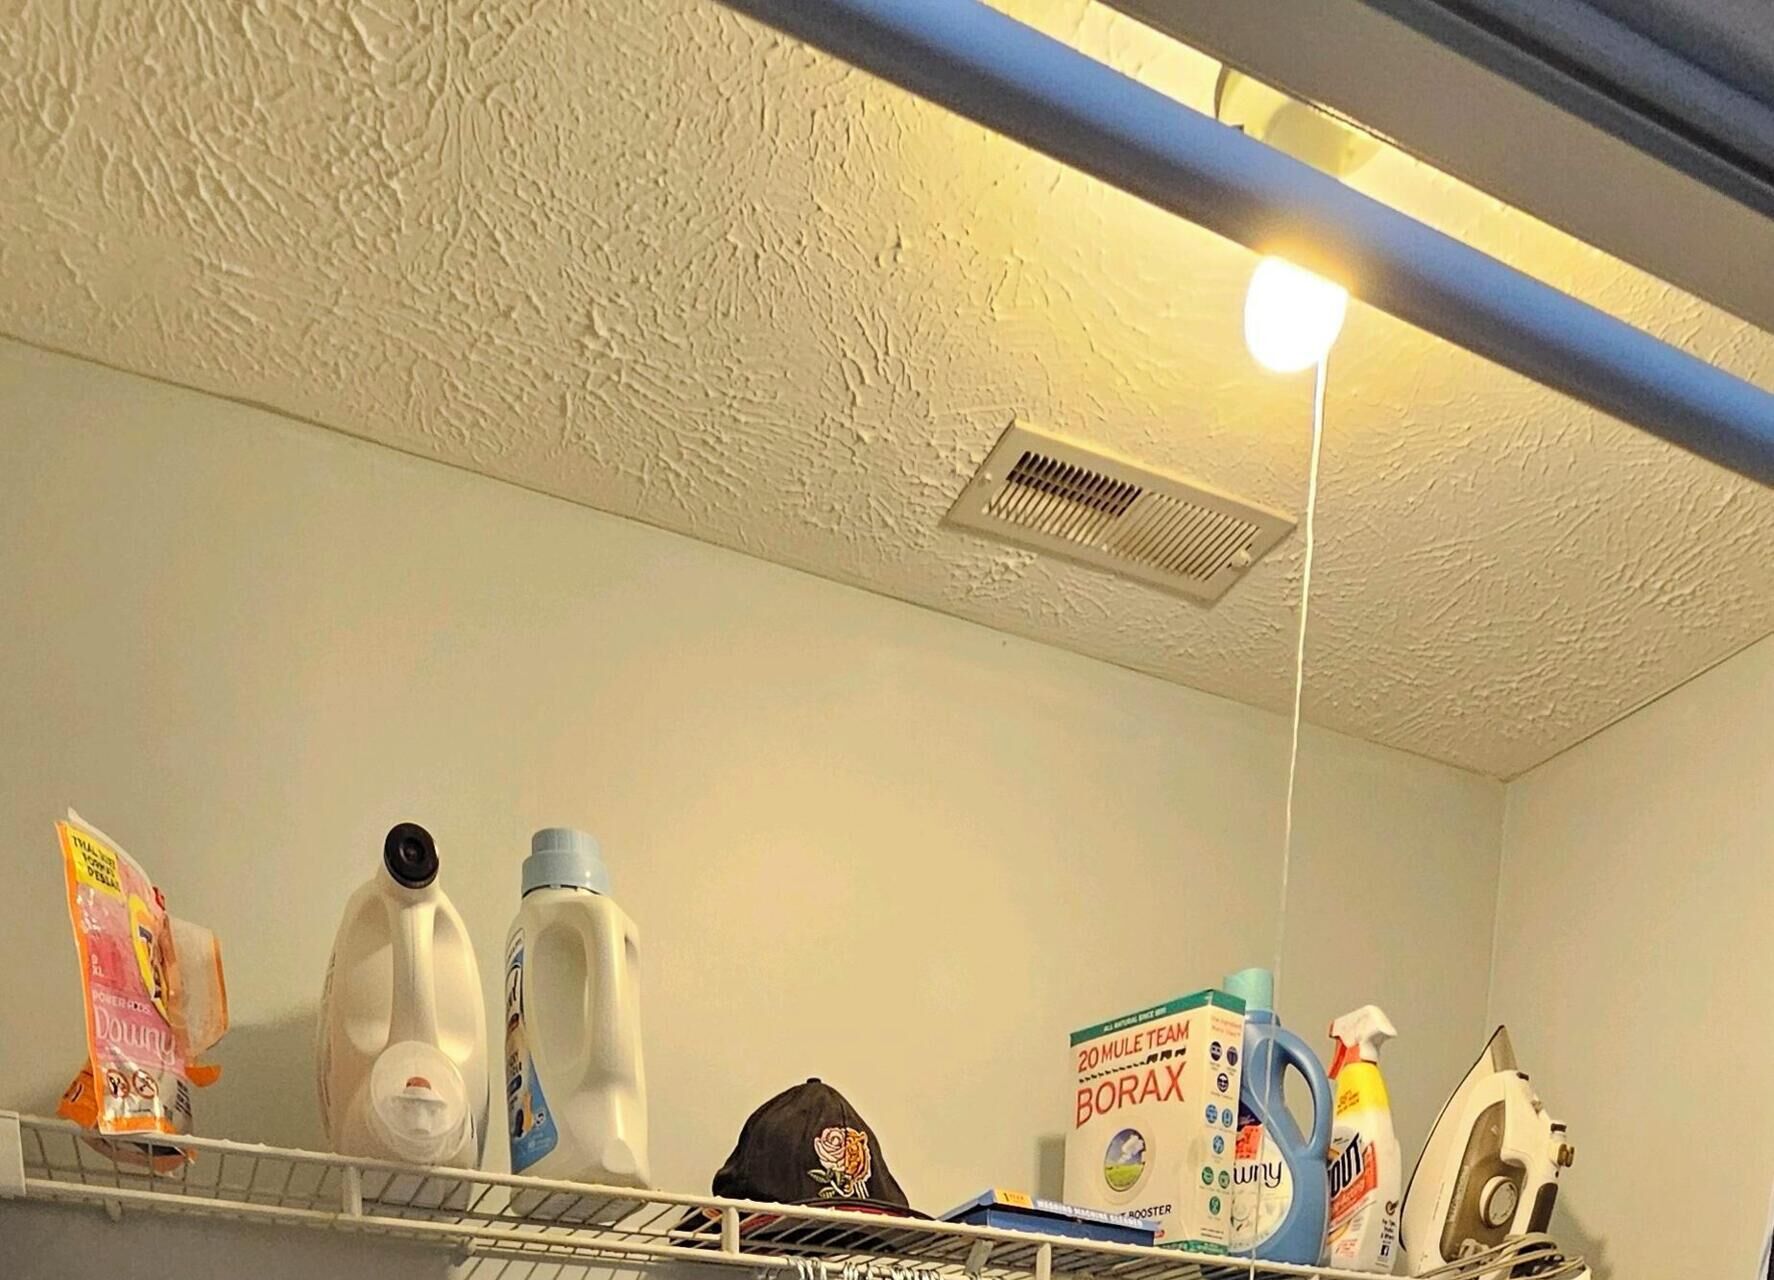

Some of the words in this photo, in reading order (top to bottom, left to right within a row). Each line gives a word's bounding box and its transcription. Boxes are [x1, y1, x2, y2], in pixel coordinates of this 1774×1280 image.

[94, 1006, 176, 1065] Downy
[1078, 1046, 1099, 1073] 20
[1101, 1033, 1143, 1064] MULE
[1146, 1020, 1190, 1050] TEAM
[1076, 1061, 1187, 1129] BORAX
[1233, 1162, 1282, 1188] wny
